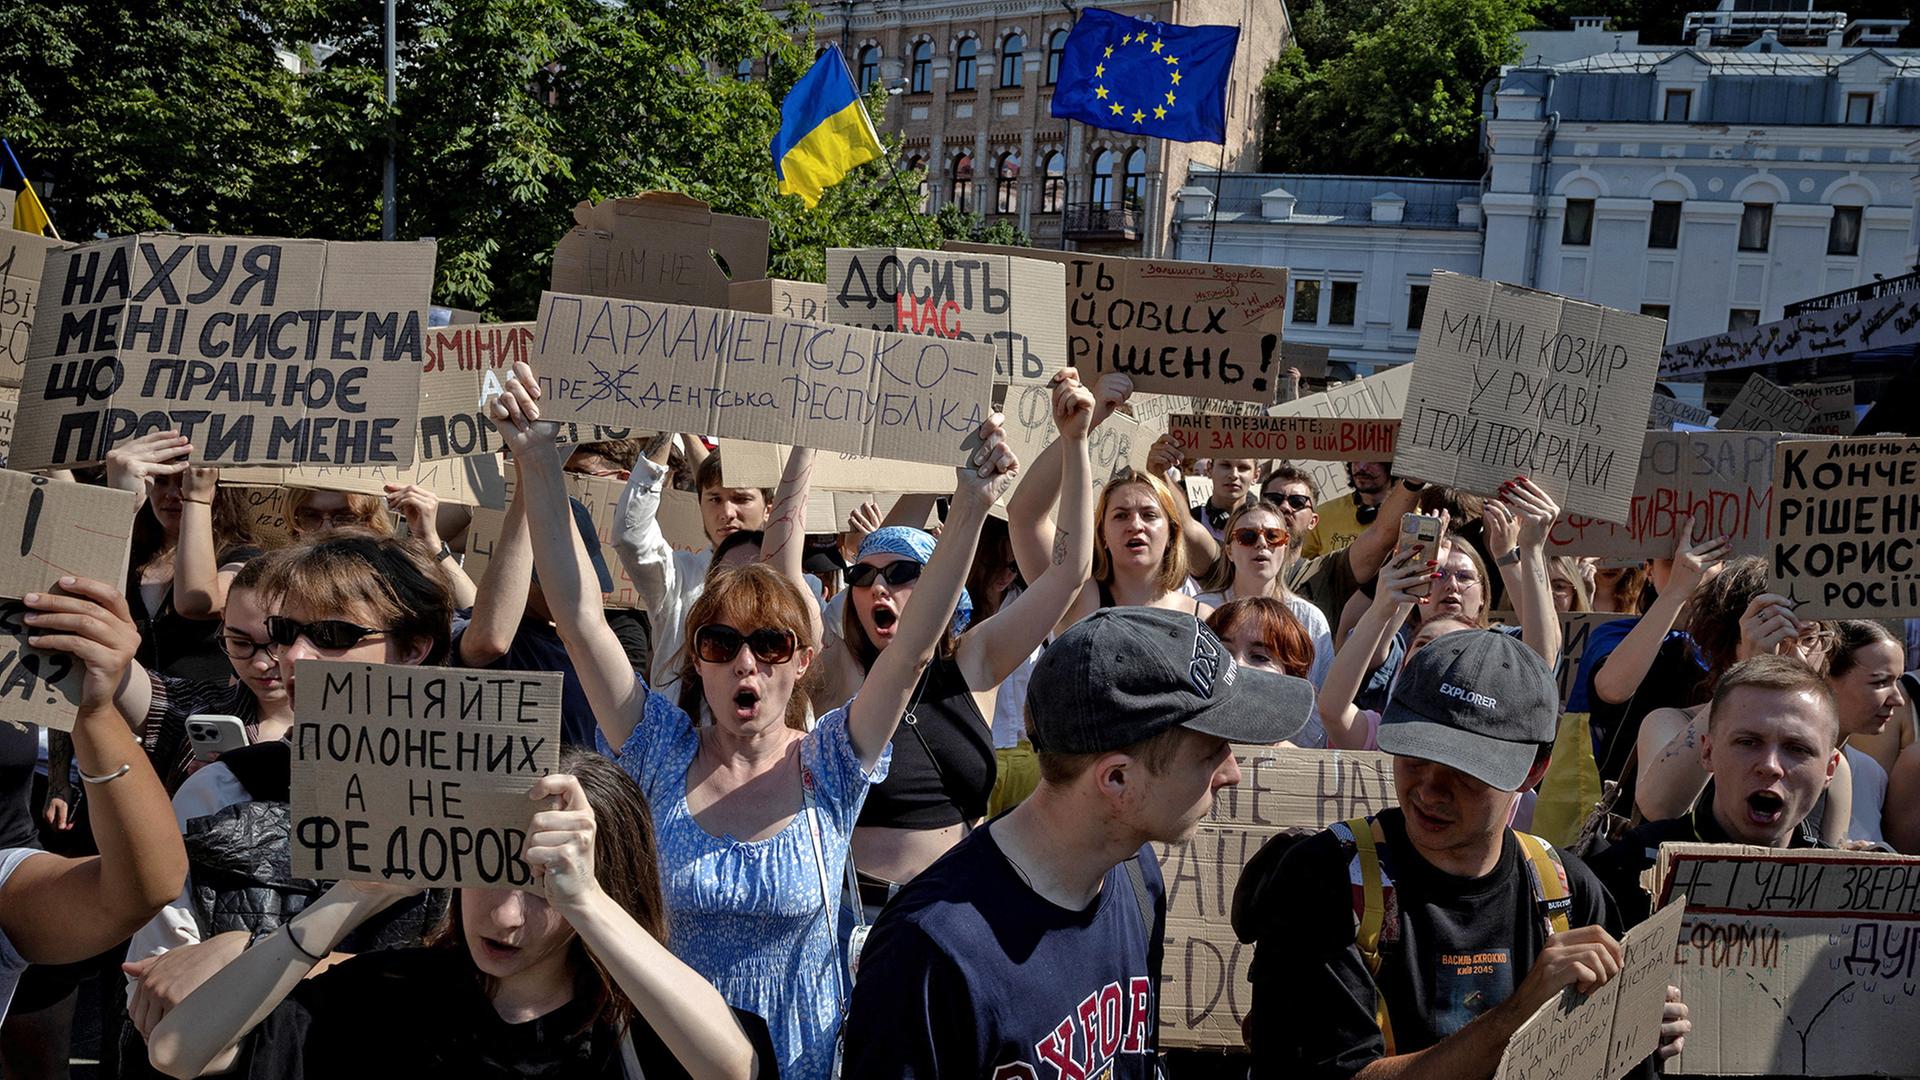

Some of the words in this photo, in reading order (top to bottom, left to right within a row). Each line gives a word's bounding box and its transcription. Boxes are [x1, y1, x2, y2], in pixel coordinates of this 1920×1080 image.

[61, 243, 282, 306] НАХУЯ
[836, 255, 1010, 315] ДОСИТЬ
[55, 305, 188, 356] МЕНІ
[200, 310, 422, 362] СИСТЕМА
[897, 292, 961, 339] НАС
[1437, 308, 1525, 364] МАЛИ
[1537, 330, 1628, 383] КОЗИР
[44, 356, 125, 405] ЩО
[140, 359, 369, 413] ПРАЦЮЄ
[1470, 363, 1499, 406] У
[52, 408, 254, 463] ПРОТИ
[267, 416, 399, 465] МЕНЕ
[1170, 415, 1213, 429] ПАНЕ
[1209, 431, 1234, 449] ЗА
[1242, 431, 1287, 451] КОГО
[1775, 538, 1920, 579] КОРИС
[1438, 682, 1498, 710] EXPLORER
[299, 722, 550, 777] ПОЛОНЕНИХ,
[345, 773, 366, 812] А
[409, 779, 465, 819] НЕ
[297, 816, 546, 886] ФЕДОРОВ
[1668, 860, 1720, 907] НЕ
[1726, 860, 1826, 911] ТУДИ
[992, 976, 1154, 1080] XFOR
